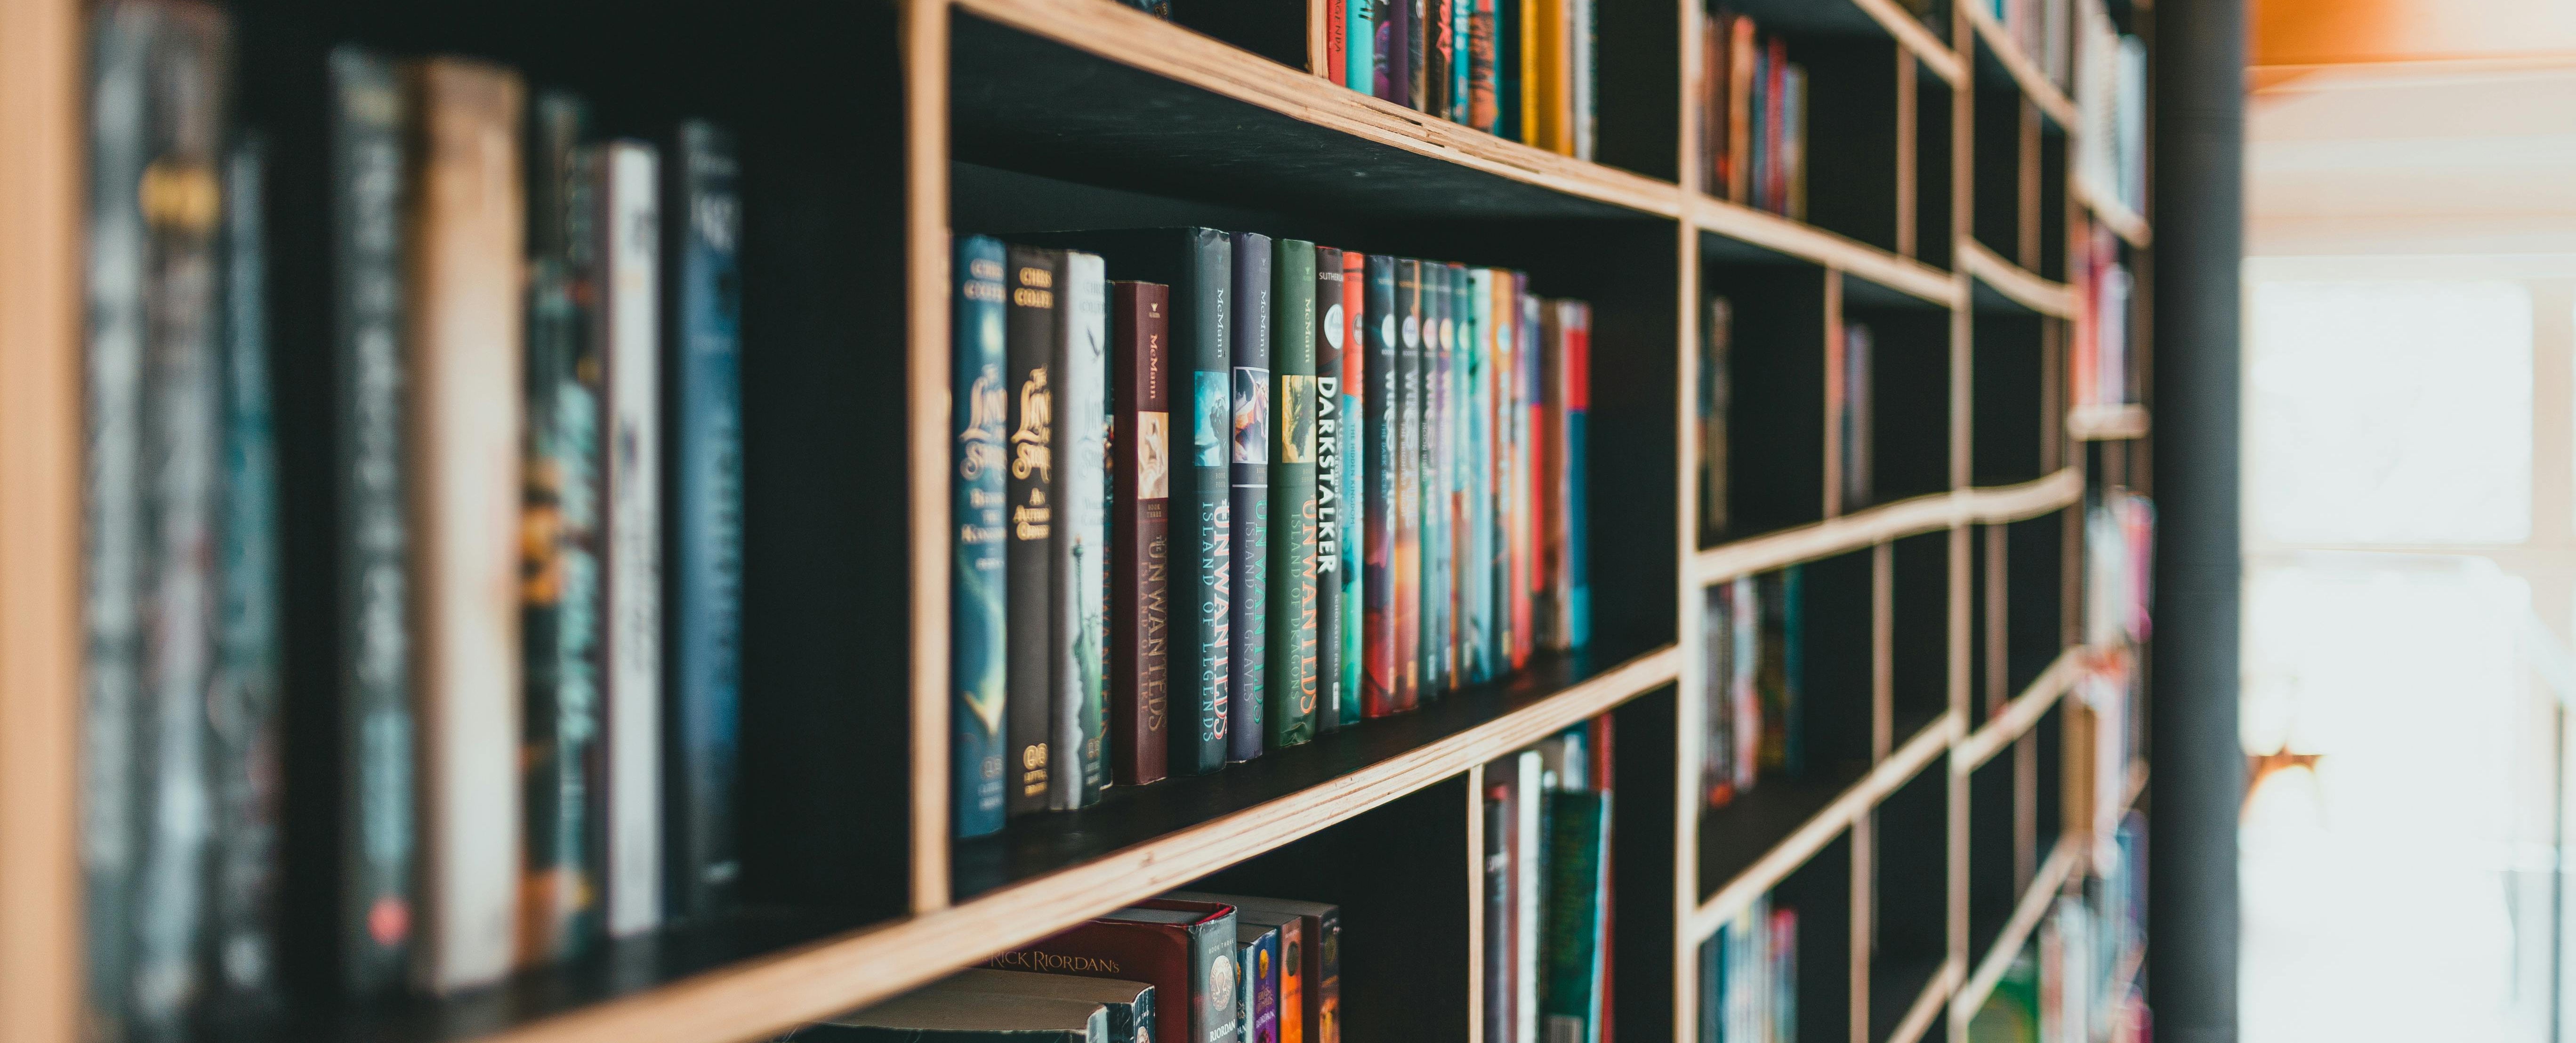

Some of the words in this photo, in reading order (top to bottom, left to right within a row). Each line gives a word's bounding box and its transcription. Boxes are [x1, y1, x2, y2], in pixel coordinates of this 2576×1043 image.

[1150, 334, 1158, 399] McMann
[1317, 377, 1337, 574] DARKSTALKER
[1203, 502, 1214, 586] ISLAND
[1245, 520, 1255, 588] ISLAND
[1291, 513, 1301, 578] ISLAND
[1203, 601, 1214, 627] OF
[1214, 505, 1229, 739] UNWANTEDS
[1244, 598, 1254, 621] OF
[1291, 587, 1301, 610] OF
[1301, 500, 1317, 715] UNWANTEDS
[1148, 540, 1167, 731] UNWANTEDS
[1243, 629, 1254, 702] GRAVES
[1291, 618, 1301, 699] DRAGONS
[1203, 642, 1214, 742] LEGENDS
[990, 951, 1031, 968] RICK
[1208, 946, 1220, 955] BOOK
[1221, 938, 1234, 949] THREE
[1209, 1019, 1236, 1043] RIORDAN
